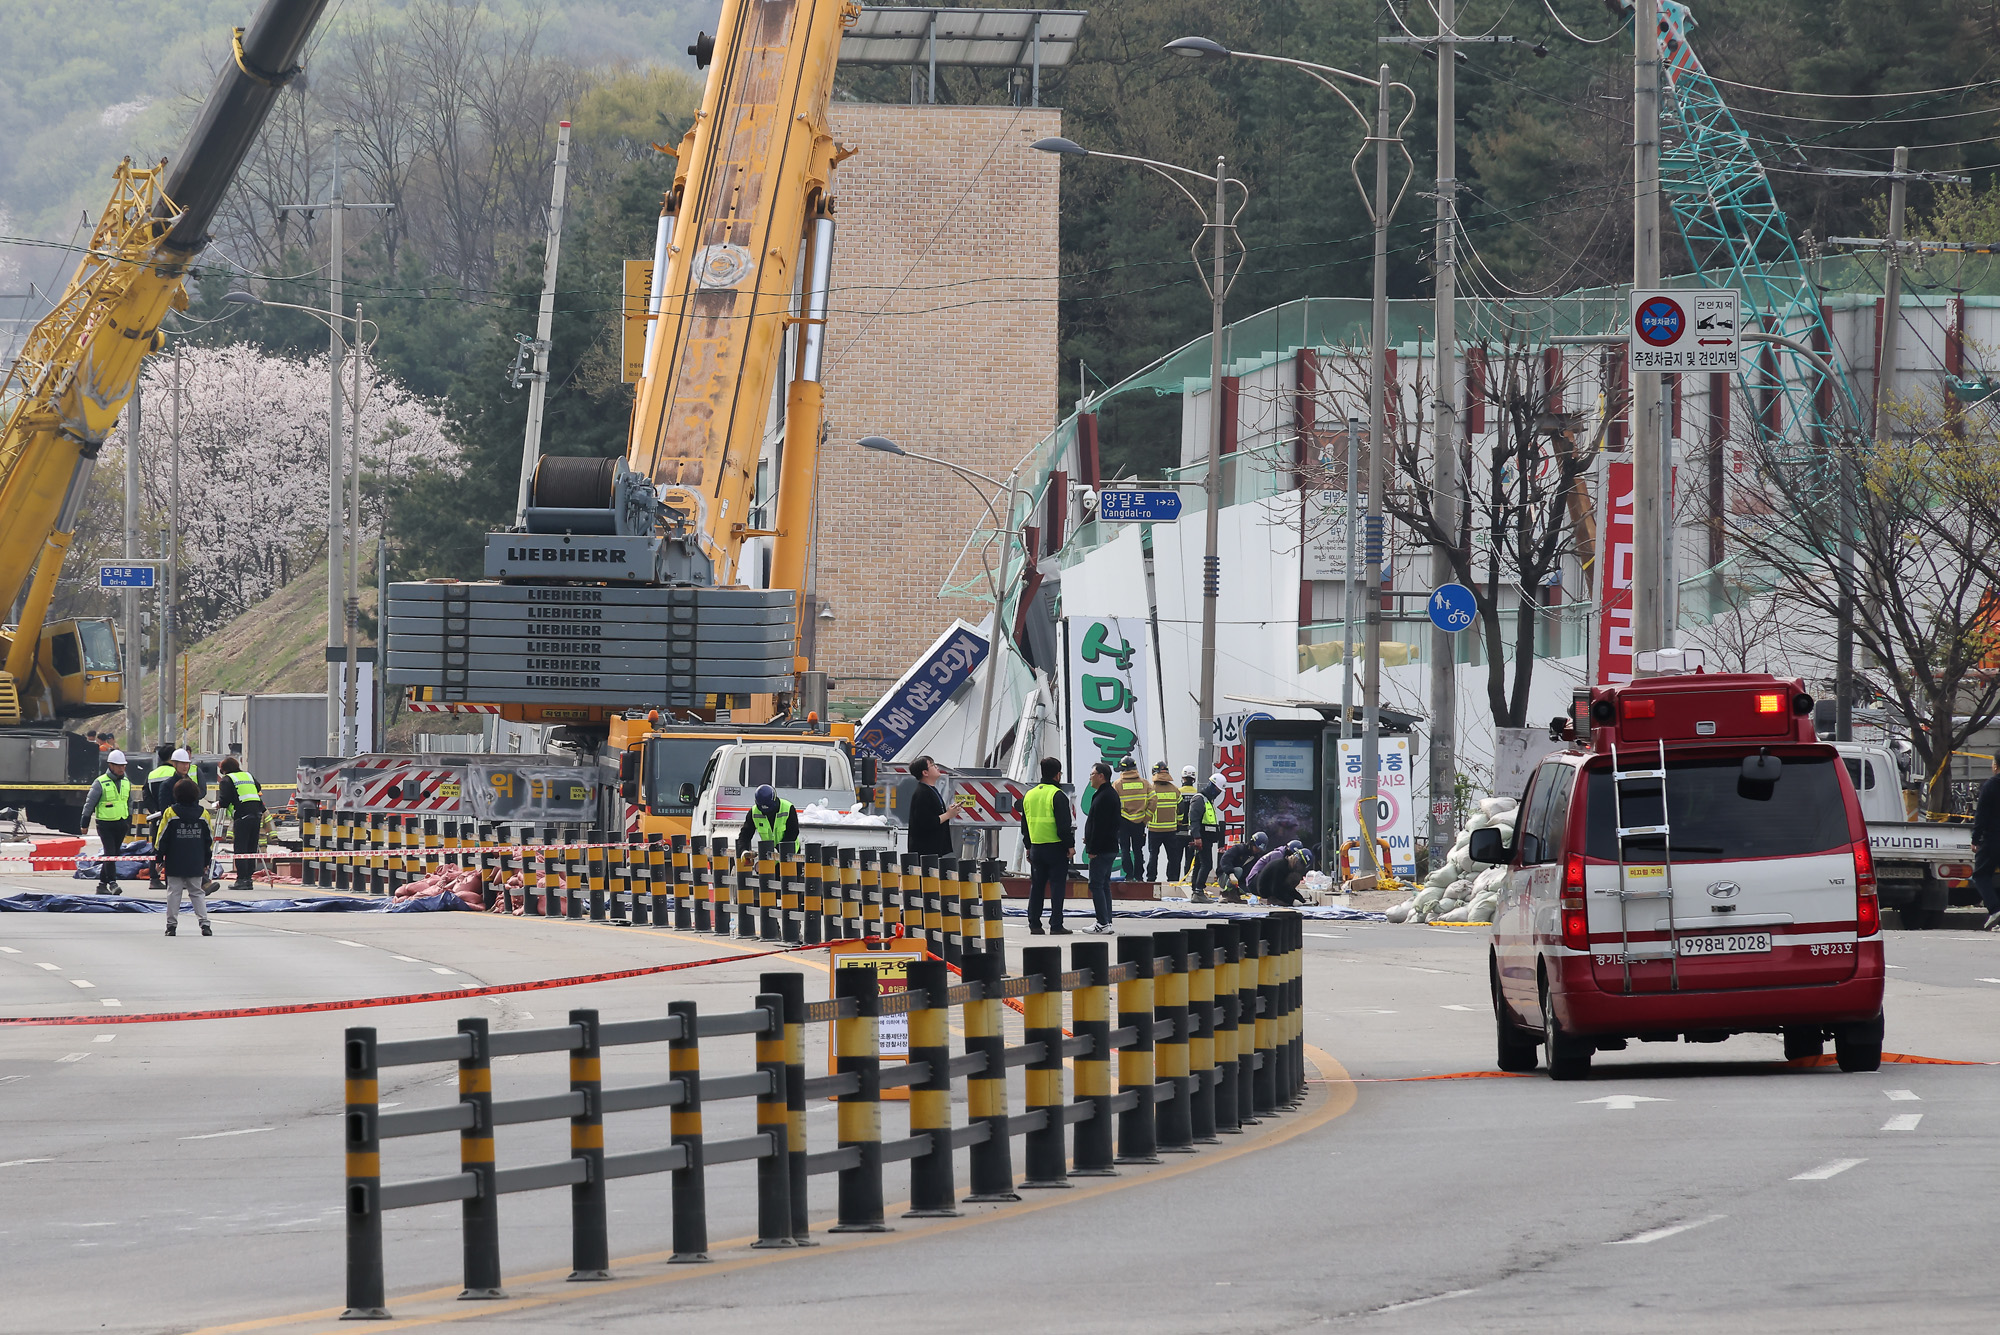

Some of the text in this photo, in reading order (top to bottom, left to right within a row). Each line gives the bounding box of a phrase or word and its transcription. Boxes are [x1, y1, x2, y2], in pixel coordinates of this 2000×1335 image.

[1697, 301, 1732, 309] 견인지역
[1644, 317, 1677, 326] 주정차금지
[1634, 351, 1737, 366] 주정차금지 및 견인지역
[1104, 493, 1146, 508] 양달로
[1103, 508, 1151, 519] Yangdal-ro
[508, 548, 626, 563] LIEBHERR
[103, 568, 132, 578] 오리로
[528, 589, 602, 601] LIEBHERR
[528, 607, 602, 619] LIEBHERR
[527, 624, 601, 636] LIEBHERR
[527, 641, 601, 653] LIEBHERR
[526, 659, 600, 671] LIEBHERR
[929, 634, 980, 684] KCC
[526, 675, 600, 687] LIEBHERR
[878, 681, 942, 739] 창호
[1345, 753, 1403, 773] 공중
[1346, 774, 1405, 788] 서시오
[1870, 836, 1939, 848] HYUNDAI
[1810, 943, 1853, 956] 광명23호
